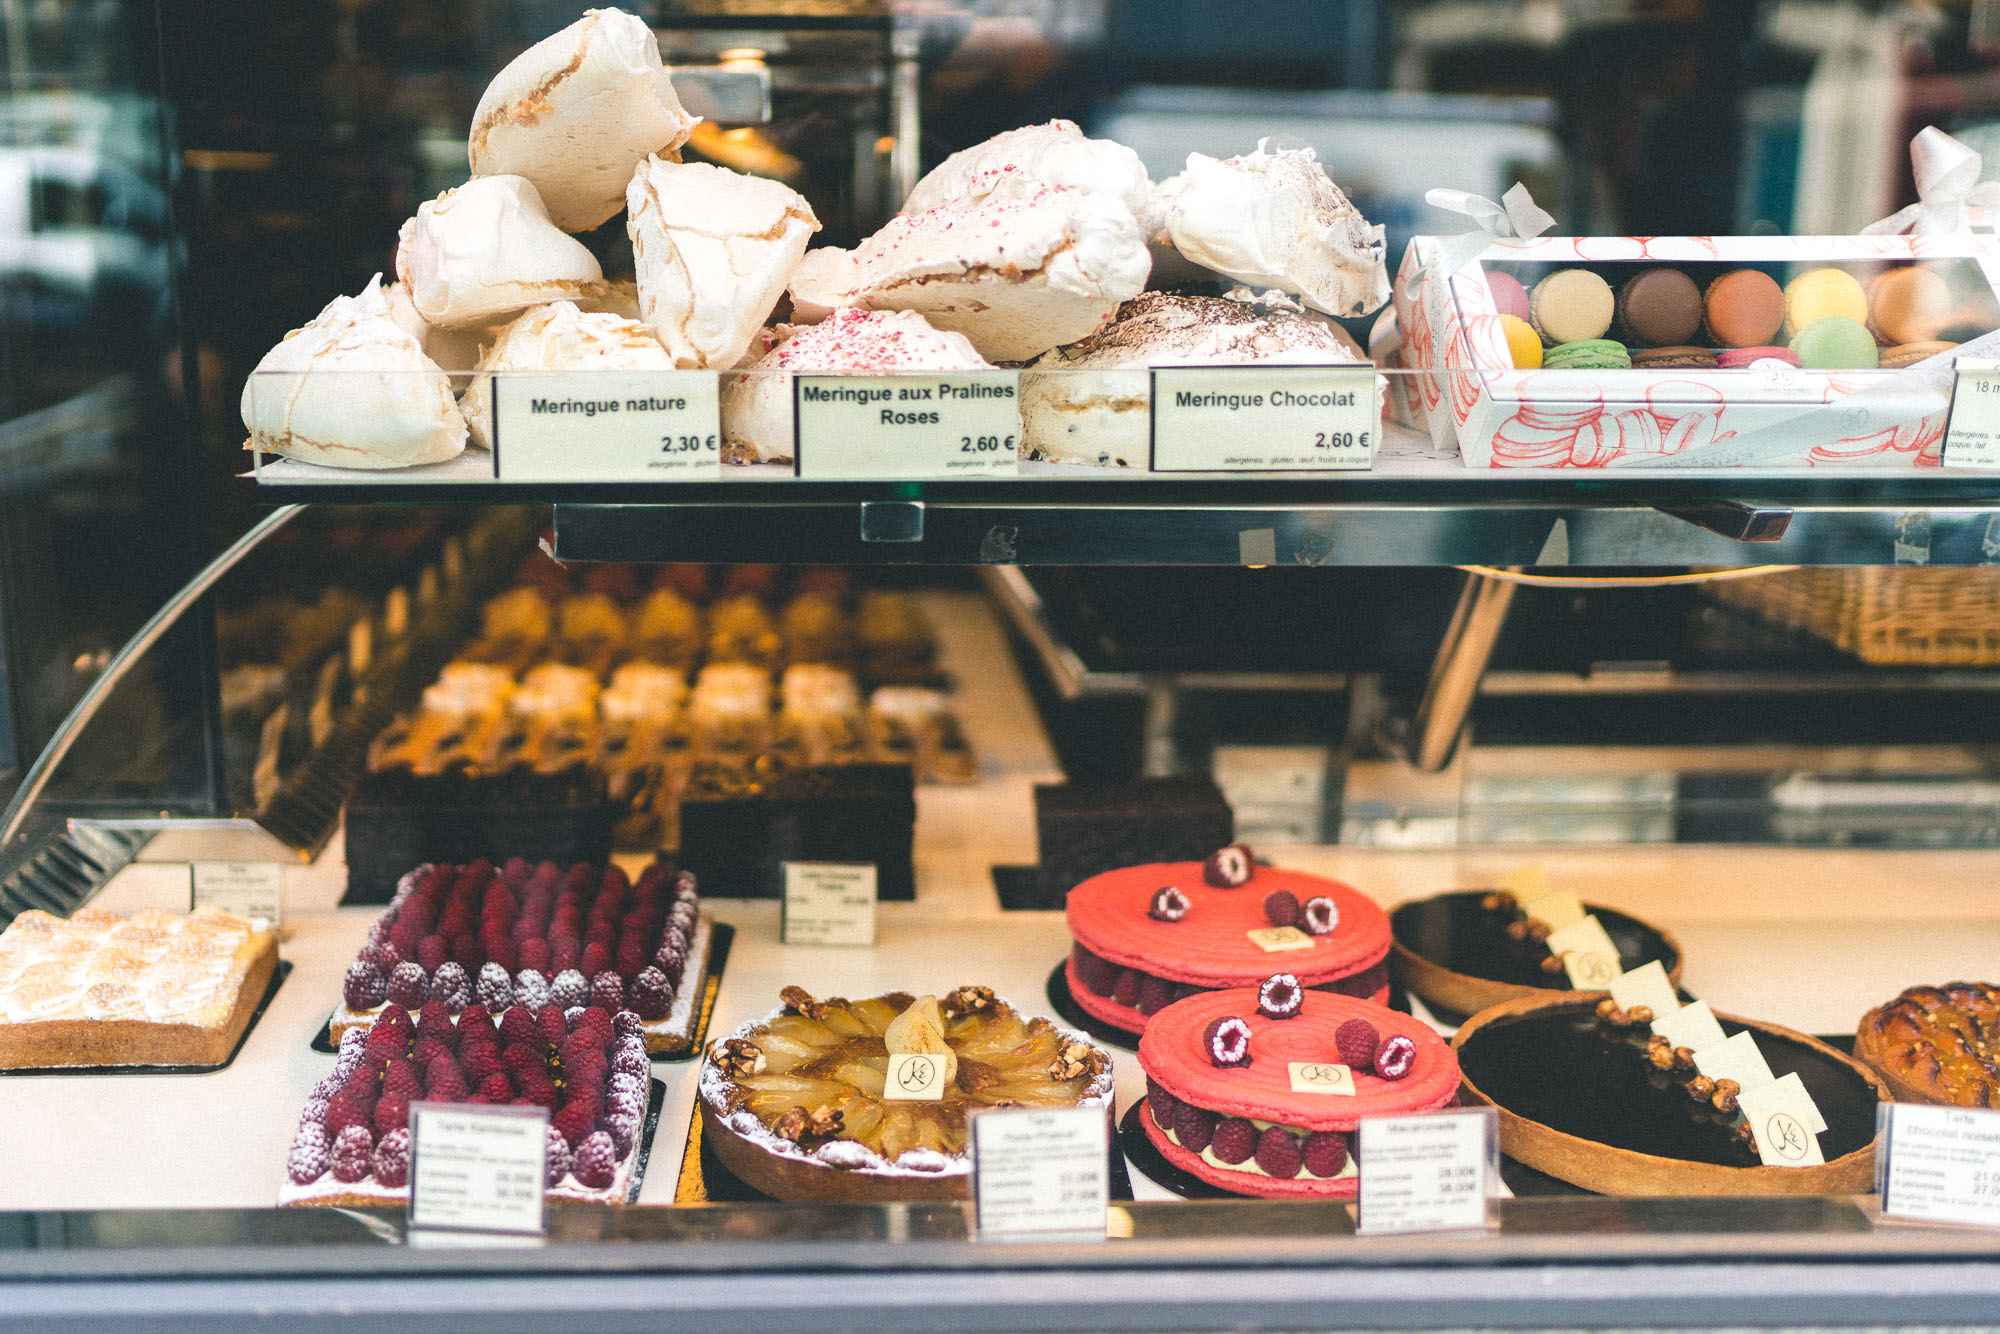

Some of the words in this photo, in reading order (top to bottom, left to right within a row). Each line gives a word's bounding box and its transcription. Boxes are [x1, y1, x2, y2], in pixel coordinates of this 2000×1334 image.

[804, 386, 892, 405] Meringue
[898, 388, 932, 400] aux
[939, 384, 1015, 399] Pralines
[1975, 381, 1989, 393] 18
[531, 398, 620, 417] Meringue
[627, 397, 686, 412] nature
[1175, 391, 1263, 411] Meringue
[1270, 391, 1355, 407] Chocolat
[880, 409, 940, 425] Roses
[661, 436, 700, 454] 2,30
[706, 435, 717, 451] €
[961, 436, 999, 453] 2,60
[1004, 435, 1015, 451] €
[1315, 432, 1353, 450] 2,60
[1358, 432, 1369, 448] €
